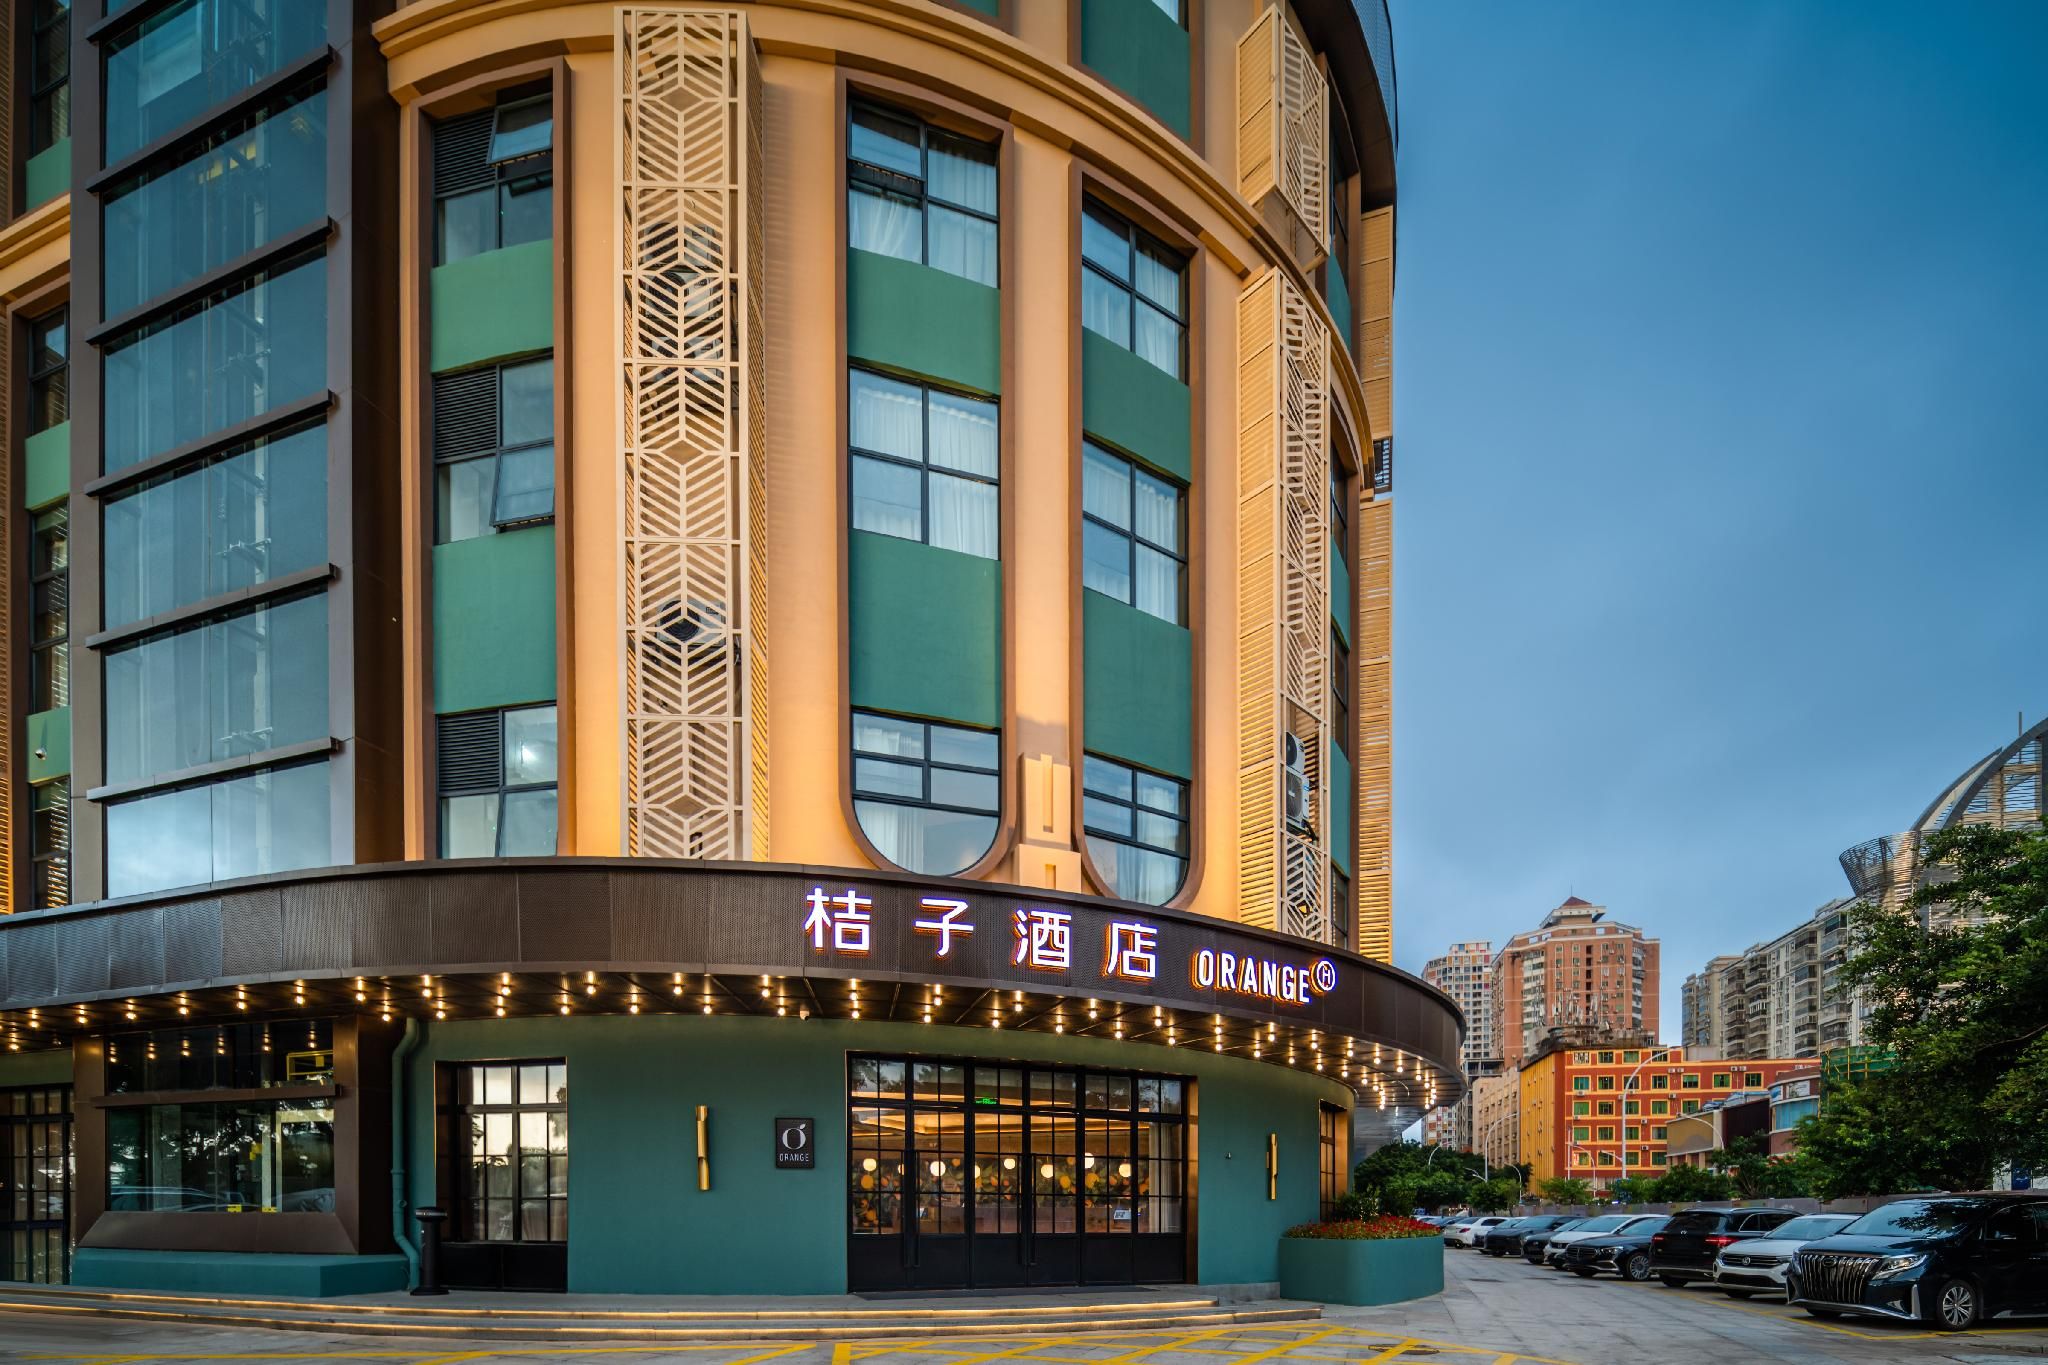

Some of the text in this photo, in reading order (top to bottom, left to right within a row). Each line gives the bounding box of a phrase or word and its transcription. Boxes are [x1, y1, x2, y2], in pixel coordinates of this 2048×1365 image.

[804, 887, 1159, 979] 桔子酒店
[1196, 949, 1311, 1003] ORANGE
[779, 1153, 809, 1162] ORANGE
